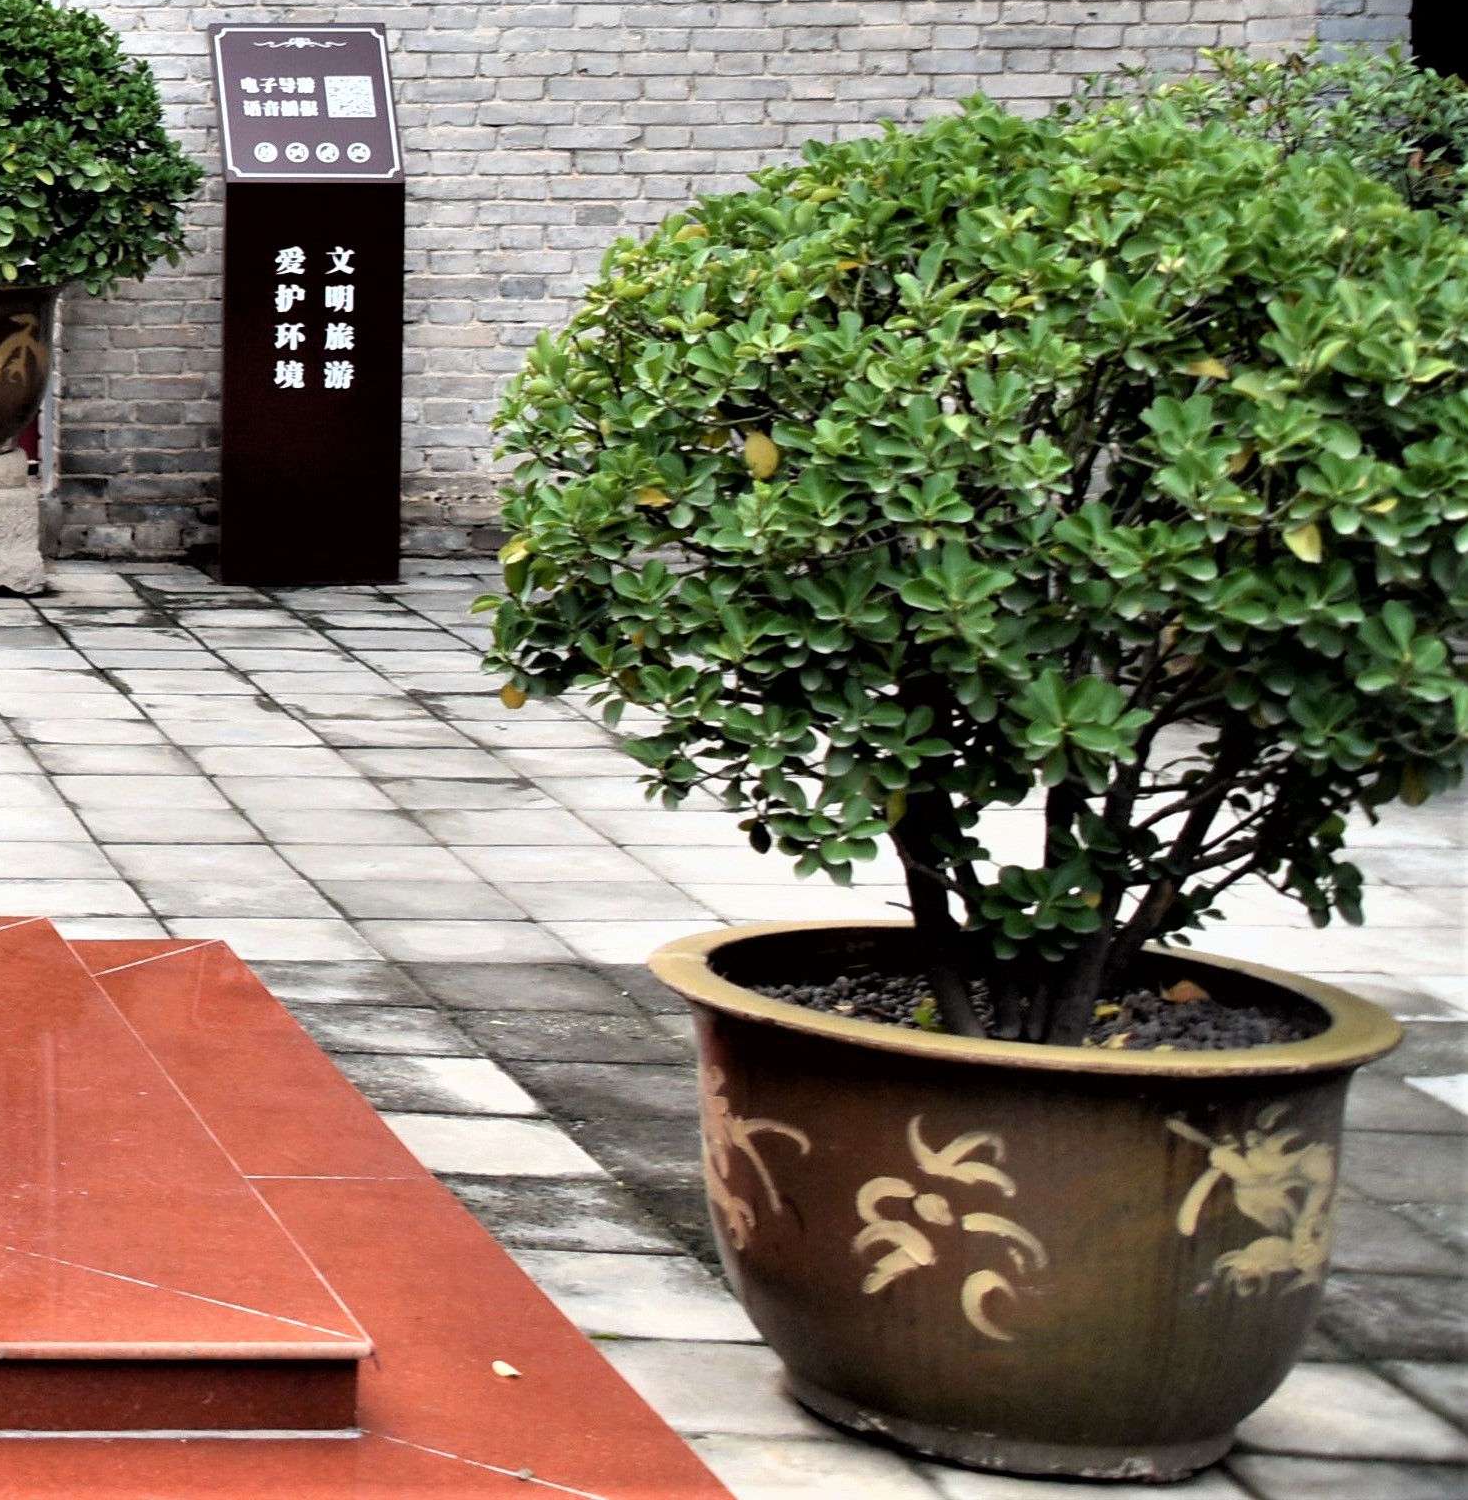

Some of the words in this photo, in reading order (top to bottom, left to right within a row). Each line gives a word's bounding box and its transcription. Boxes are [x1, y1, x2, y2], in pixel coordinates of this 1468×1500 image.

[273, 245, 307, 389] 爱护环境
[323, 246, 356, 390] 文明旅游
